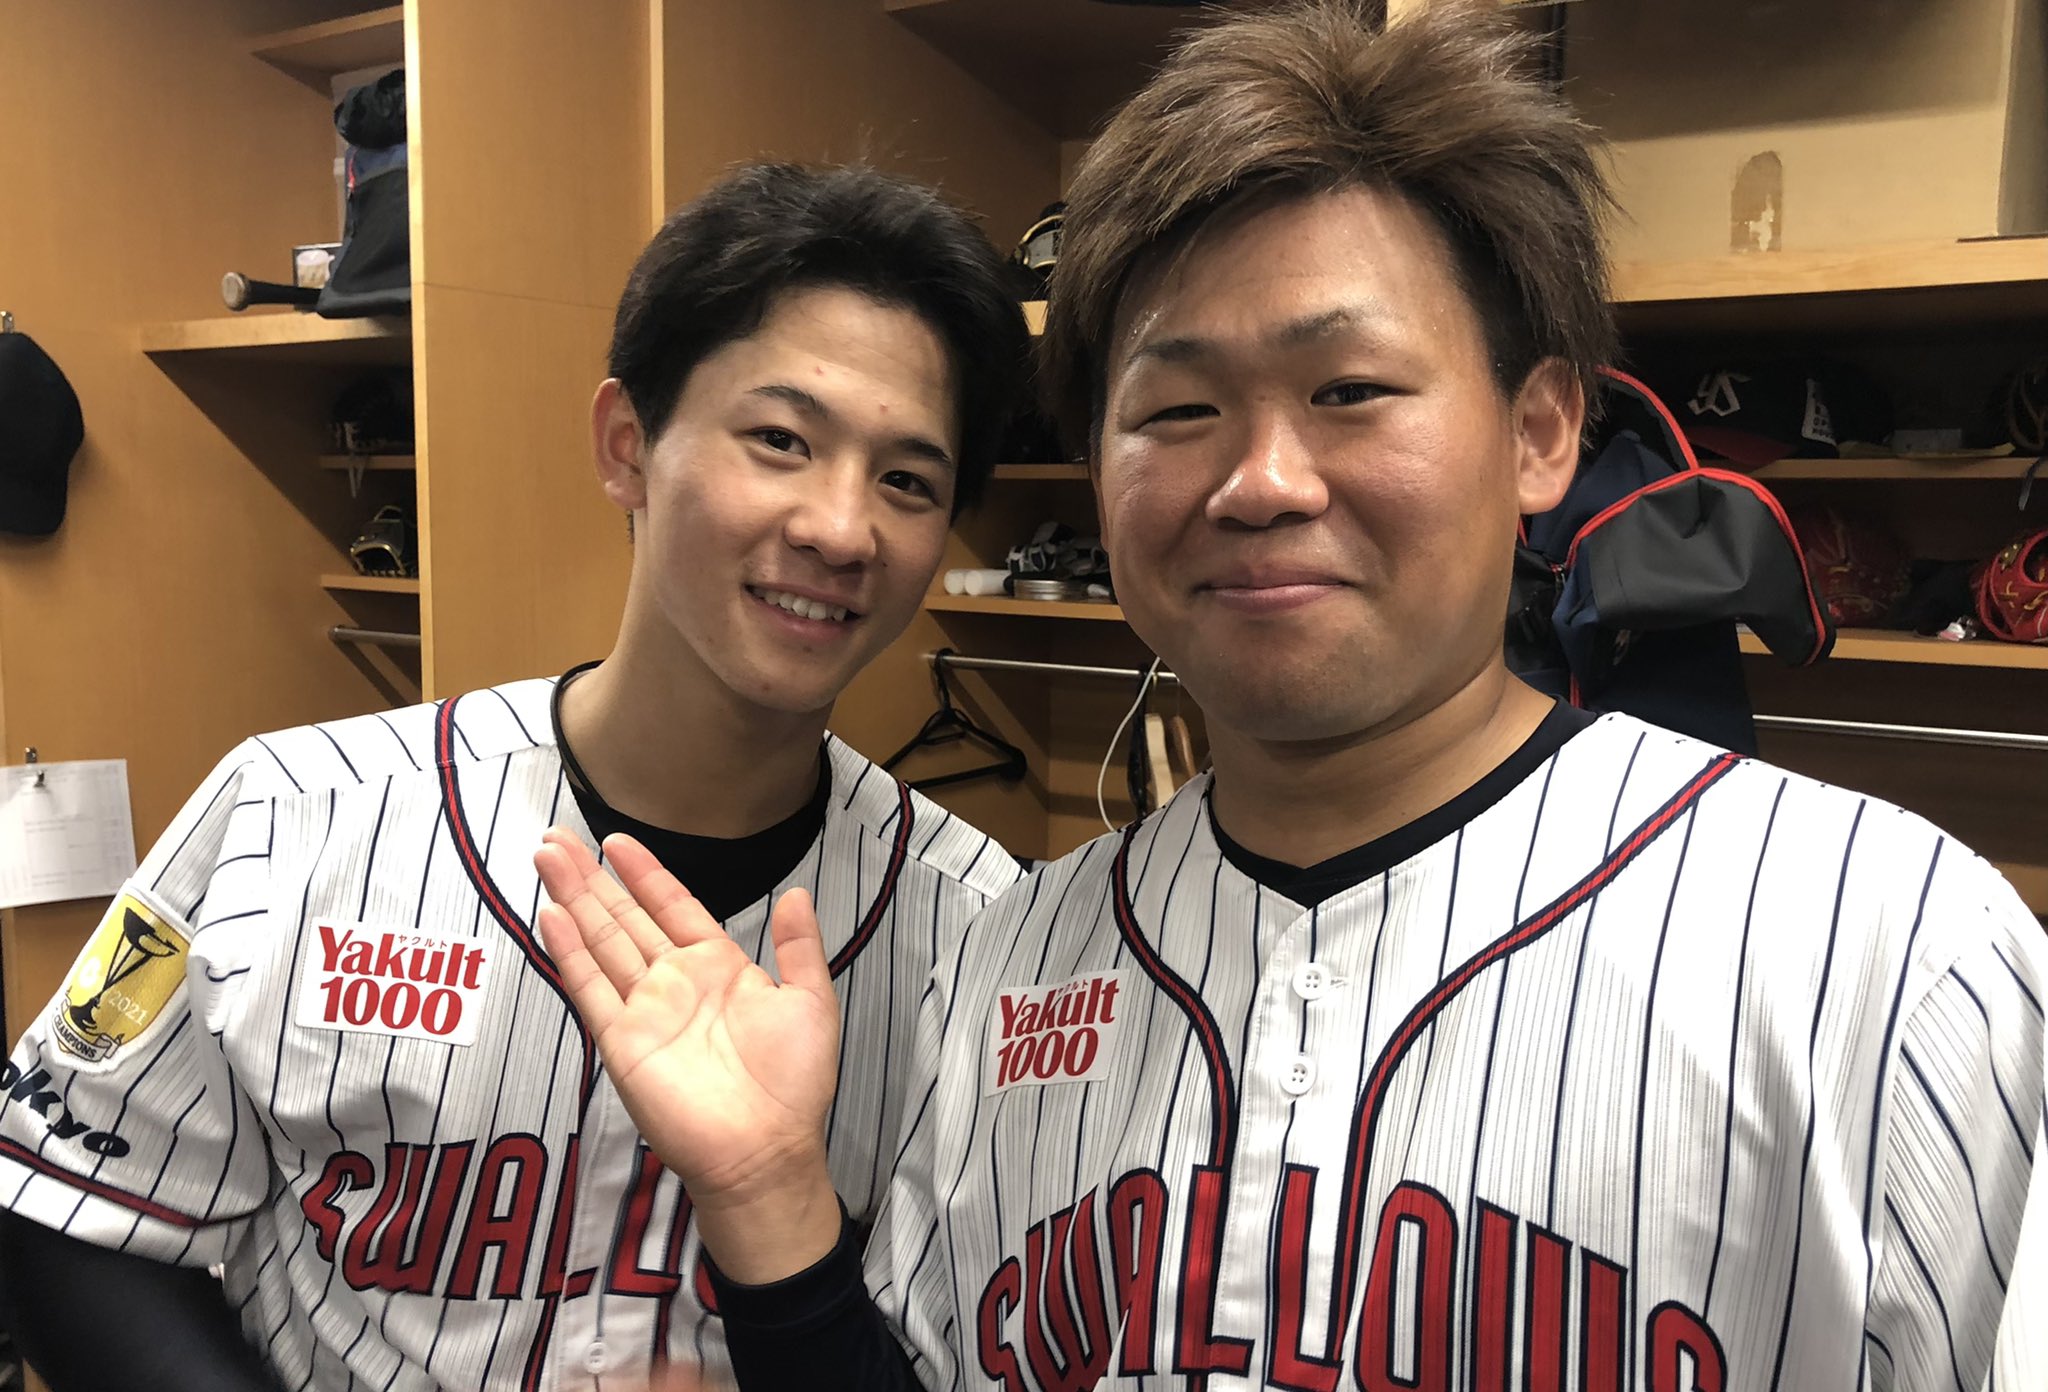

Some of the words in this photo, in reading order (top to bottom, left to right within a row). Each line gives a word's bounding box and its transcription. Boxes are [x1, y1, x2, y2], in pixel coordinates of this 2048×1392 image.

[318, 925, 486, 990] Yakult
[398, 934, 448, 950] ヤクルト
[53, 1014, 97, 1059] CHAMPIONS
[108, 992, 149, 1026] 2021
[320, 976, 463, 1036] 1000
[1000, 977, 1120, 1039] Yakult
[996, 1026, 1099, 1088] 1000
[302, 1132, 719, 1315] SWALL
